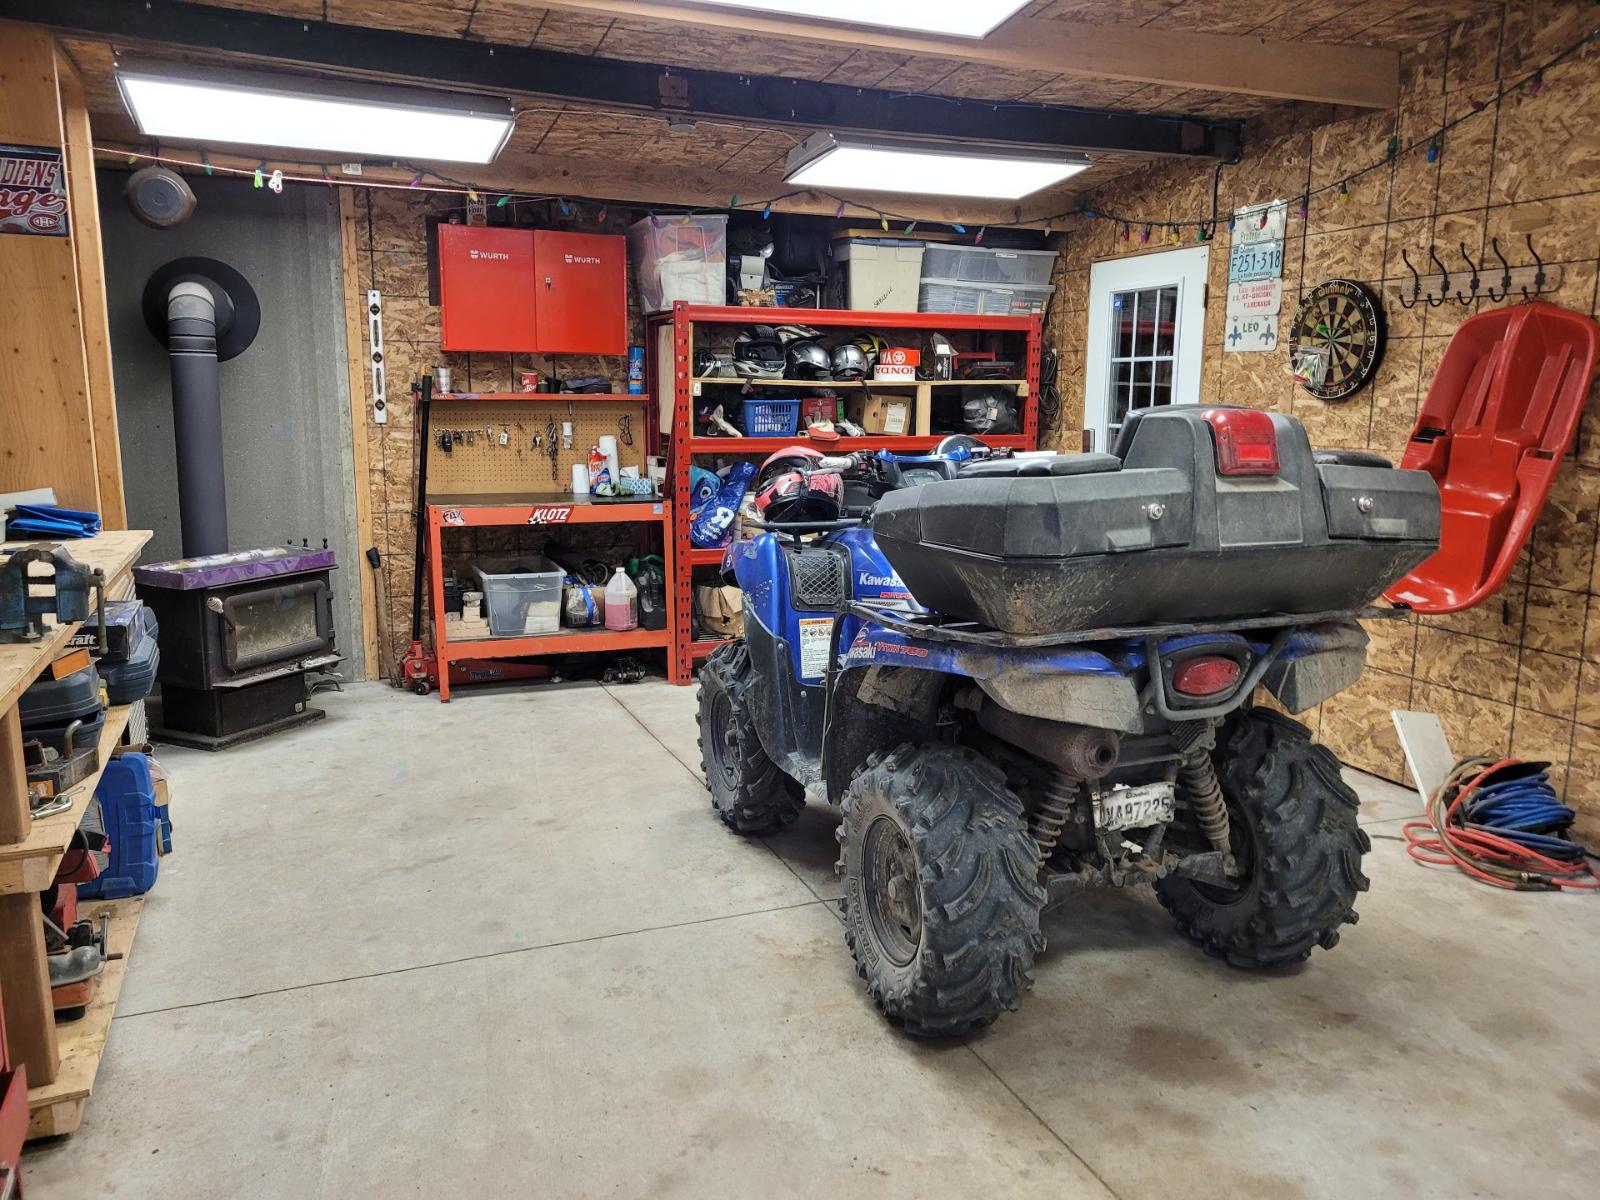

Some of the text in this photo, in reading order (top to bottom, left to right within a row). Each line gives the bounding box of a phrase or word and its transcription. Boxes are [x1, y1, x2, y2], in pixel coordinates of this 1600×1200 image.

[0, 159, 60, 187] DIENS
[1231, 250, 1281, 272] F251-318
[531, 507, 571, 521] KLOTZ
[859, 572, 906, 588] Kawasa
